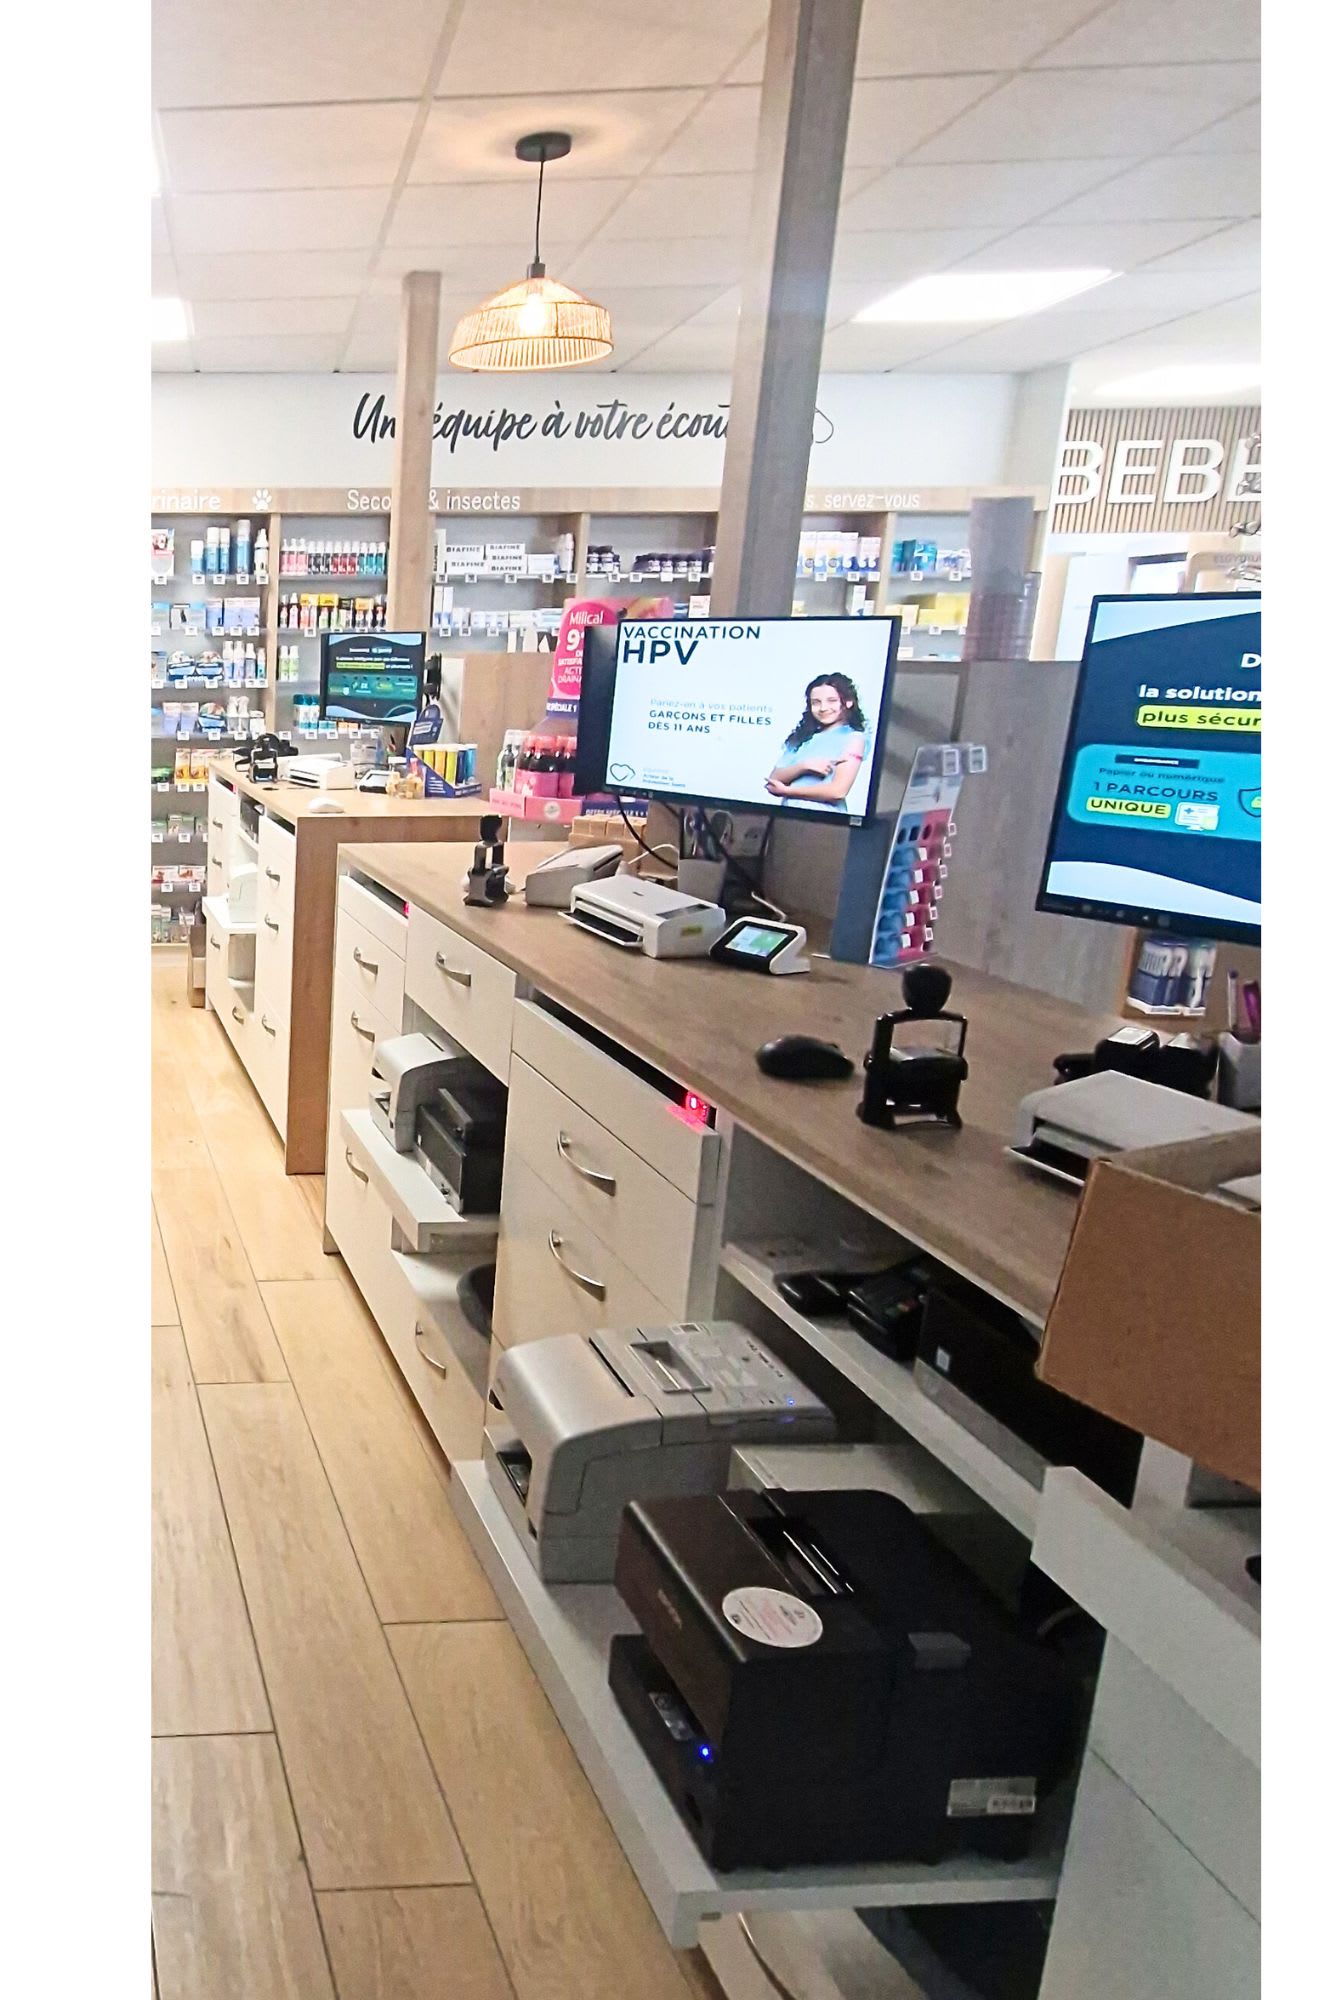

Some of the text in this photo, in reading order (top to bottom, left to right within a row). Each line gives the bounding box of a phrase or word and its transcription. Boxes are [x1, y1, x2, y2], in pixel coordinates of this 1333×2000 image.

[353, 392, 731, 454] Un équipe à votre écou
[347, 489, 521, 511] Seco & insectes
[824, 493, 921, 509] servez-vous
[569, 610, 604, 625] Milical
[623, 625, 761, 640] VACCINATION
[623, 640, 699, 665] HPV
[1241, 653, 1261, 668] D
[1138, 684, 1261, 702] la solution
[649, 709, 772, 726] GARÇONS ET FILLES
[1142, 710, 1261, 727] plus sécur
[686, 725, 711, 734] ANS
[1094, 781, 1219, 801] 1 PARCOURS
[1090, 798, 1167, 815] UNIQUE
